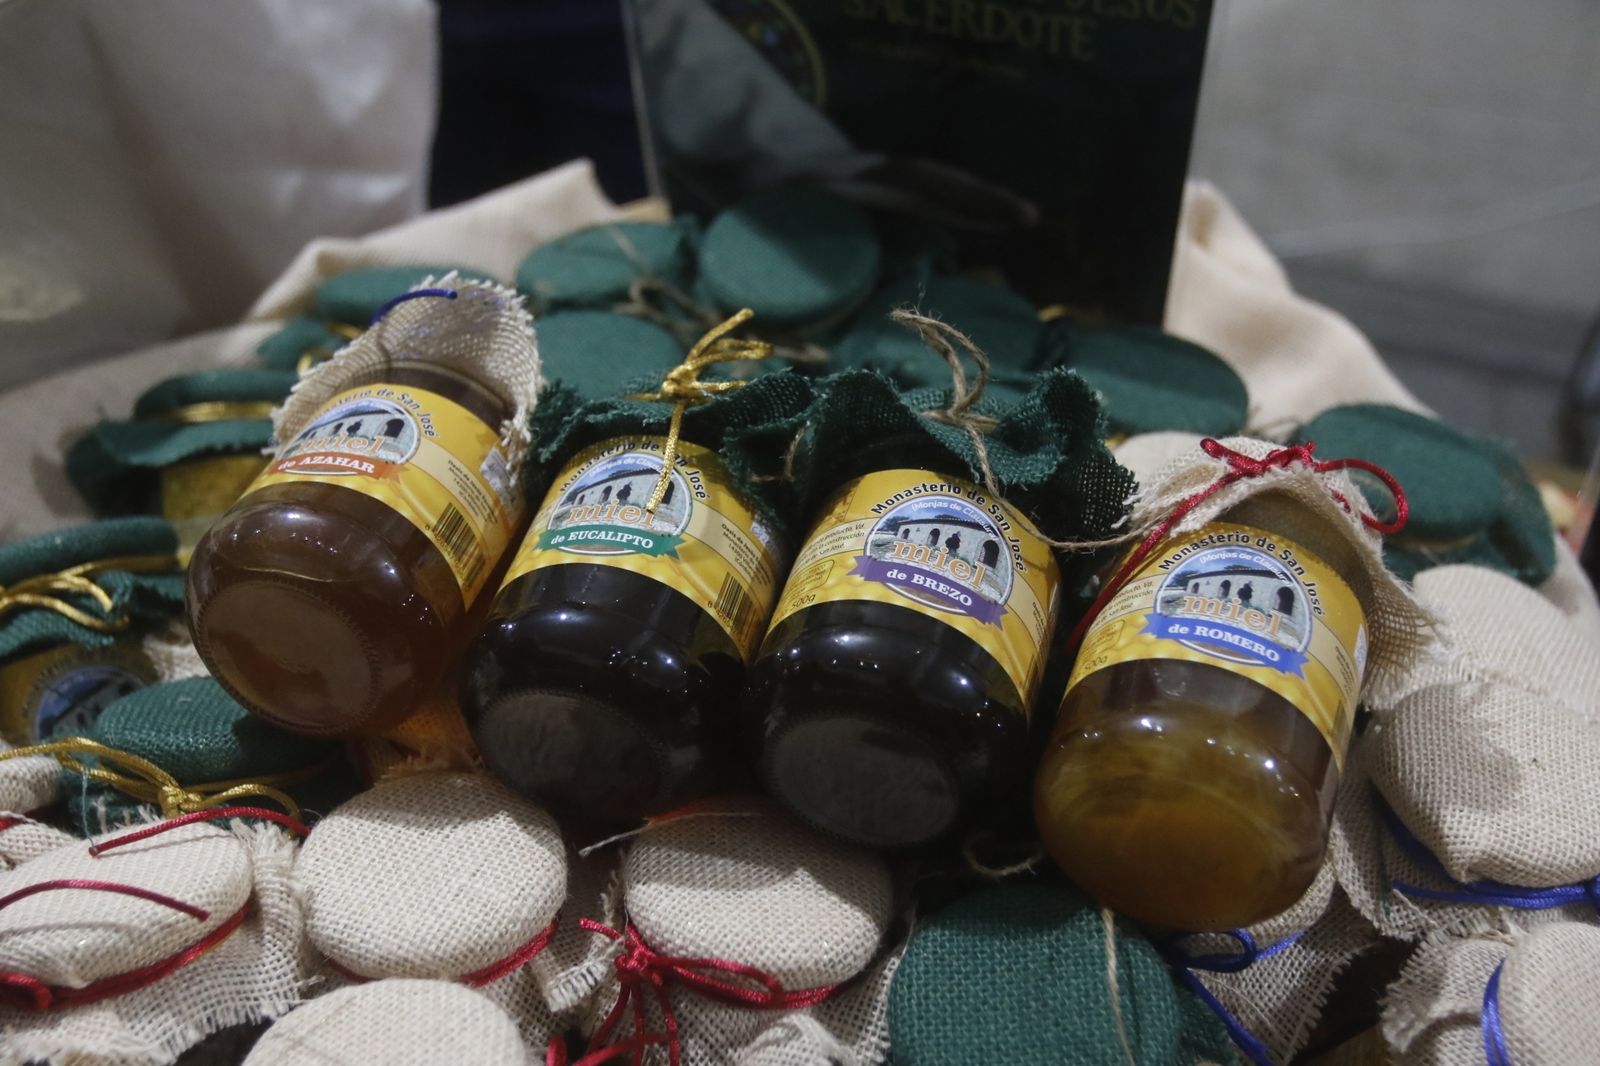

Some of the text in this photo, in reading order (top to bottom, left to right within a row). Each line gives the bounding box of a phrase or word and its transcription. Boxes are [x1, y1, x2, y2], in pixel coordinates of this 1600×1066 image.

[1062, 0, 1198, 31] SUS
[376, 387, 394, 397] de
[397, 392, 421, 410] San
[416, 410, 439, 438] José
[300, 432, 386, 453] miel
[277, 455, 376, 474] de AZAHAR
[640, 439, 660, 452] de
[685, 468, 711, 499] José
[566, 498, 655, 528] miel
[911, 500, 949, 512] (Monjas
[949, 501, 962, 511] de
[550, 530, 654, 550] de EUCALIPTO
[871, 482, 1028, 572] Monasterio de San José
[891, 539, 989, 589] miel
[1157, 531, 1325, 615] Monasterio de San José
[1199, 551, 1238, 564] (Monjas
[1238, 552, 1253, 561] de
[886, 568, 973, 607] de BREZO
[1180, 594, 1282, 640] miel
[1168, 624, 1281, 663] de ROMERO
